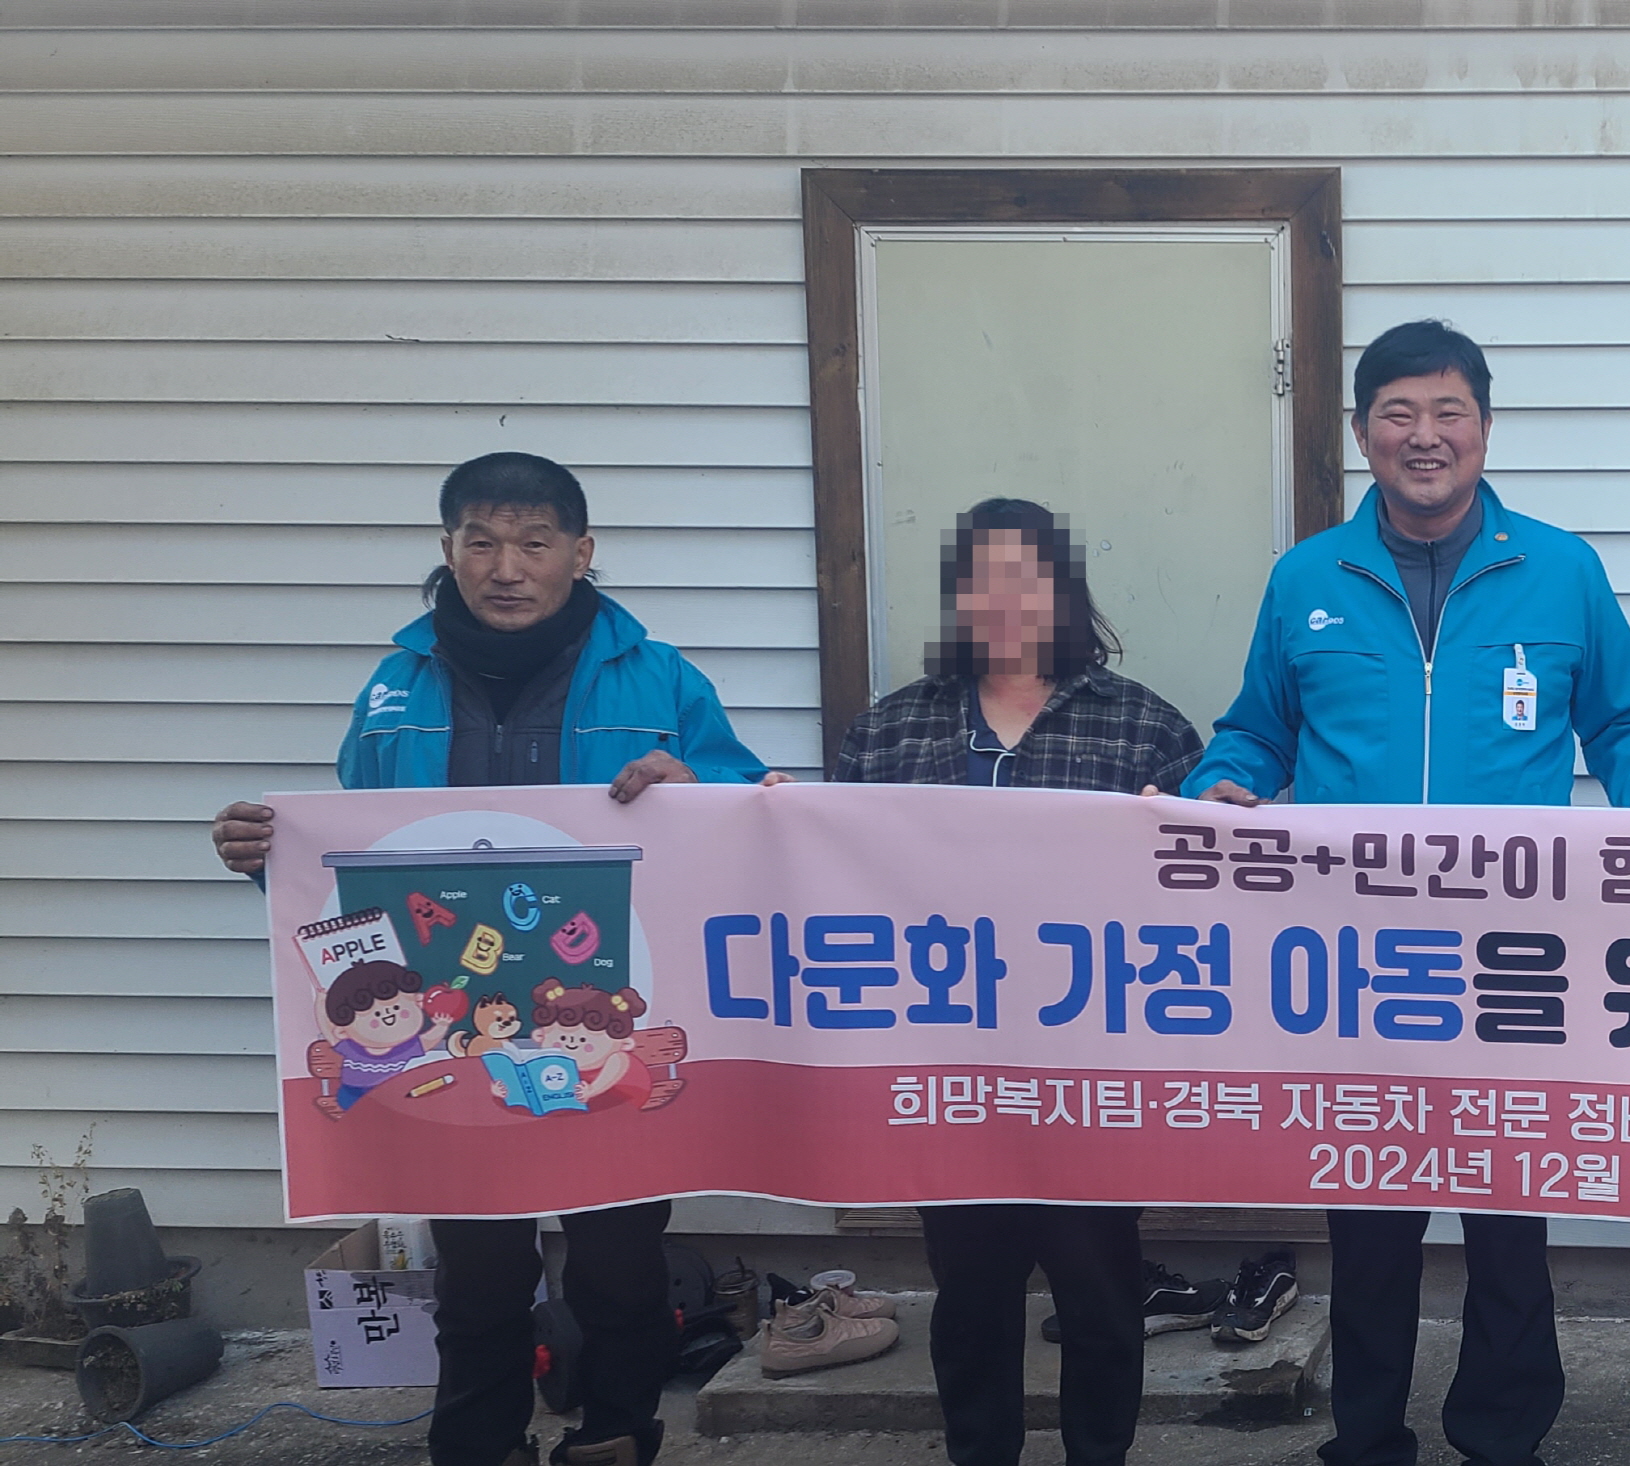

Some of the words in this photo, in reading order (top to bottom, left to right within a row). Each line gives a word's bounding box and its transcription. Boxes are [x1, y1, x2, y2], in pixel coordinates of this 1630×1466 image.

[1153, 823, 1567, 902] 공공+민간이
[440, 890, 467, 900] Apple
[542, 895, 561, 904] Cat
[322, 933, 387, 965] APPLE
[502, 952, 524, 962] Bear
[594, 958, 614, 968] Dog
[704, 911, 1008, 1031] 다문화
[1037, 920, 1234, 1036] 가정
[1270, 925, 1569, 1045] 아동을
[888, 1075, 1263, 1131] 희망복지팀·경북
[1280, 1082, 1434, 1134] 자동차
[1449, 1088, 1550, 1139] 전문
[1308, 1143, 1493, 1195] 2024년
[1514, 1151, 1620, 1202] 12월
